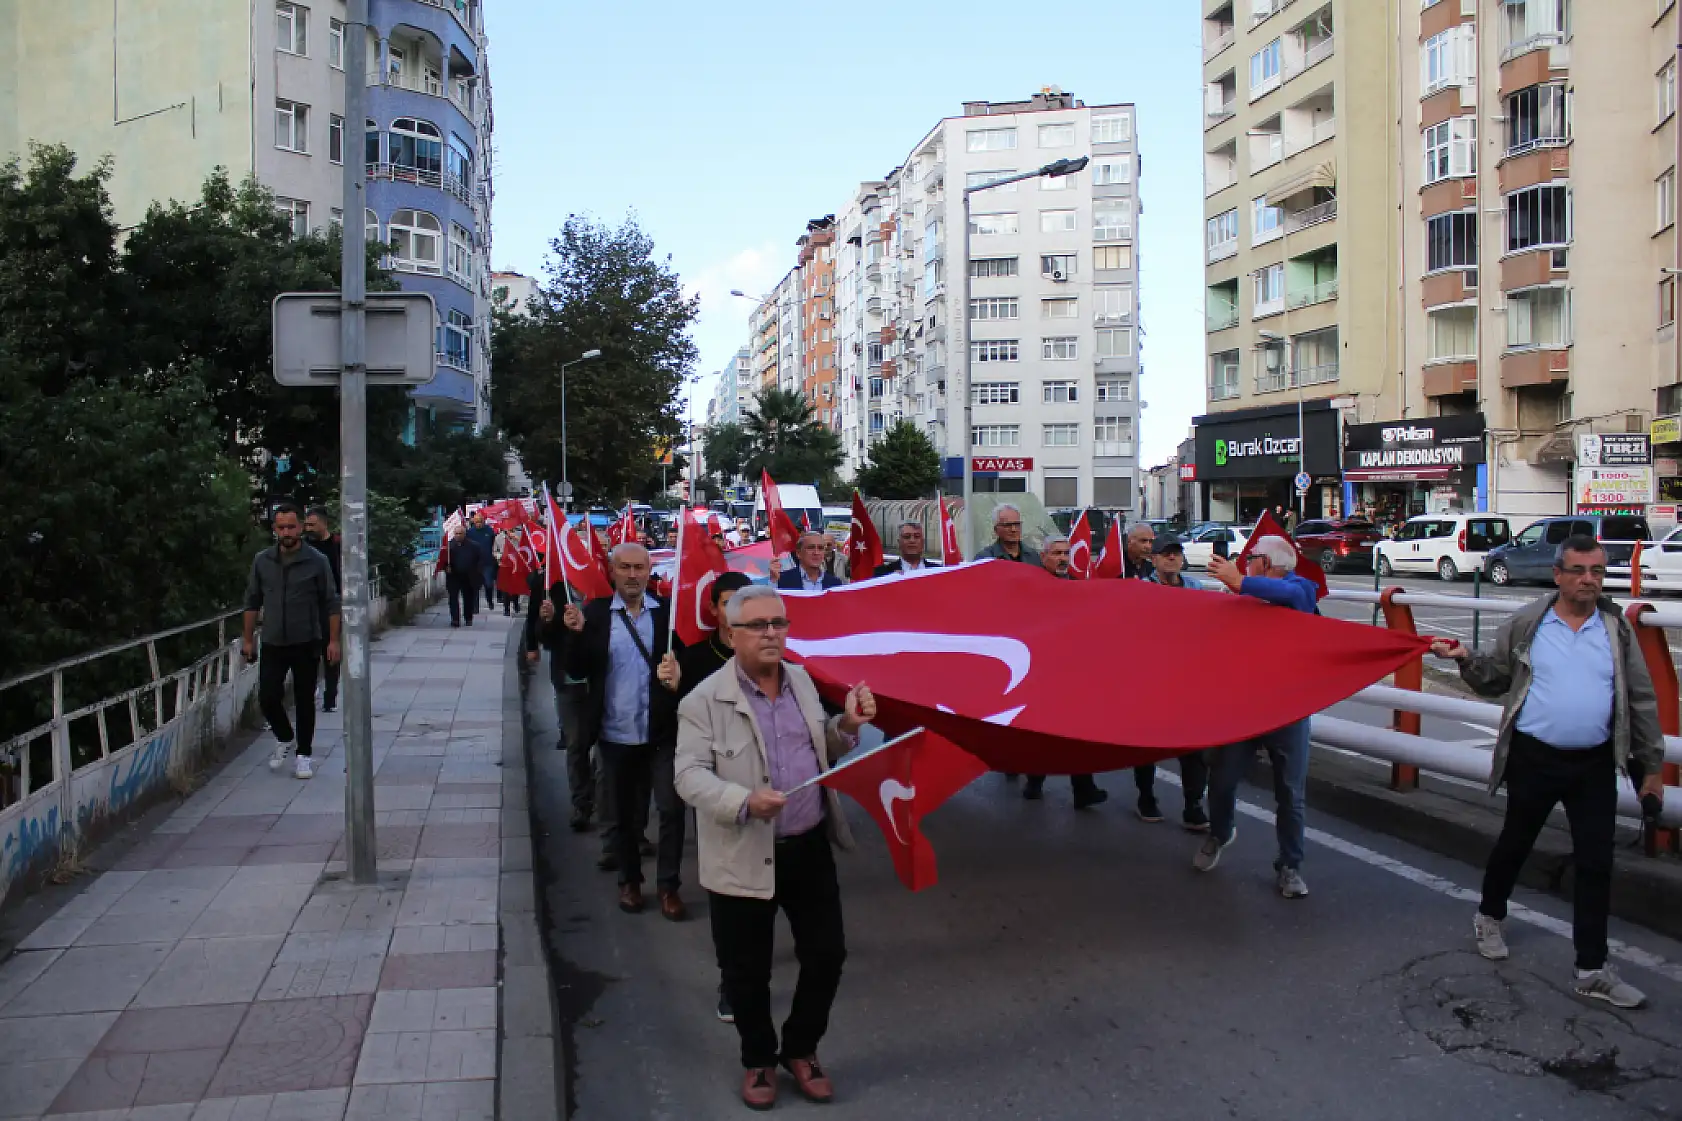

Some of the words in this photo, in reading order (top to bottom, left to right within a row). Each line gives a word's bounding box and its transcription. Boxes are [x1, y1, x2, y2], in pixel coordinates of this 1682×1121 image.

[1228, 437, 1262, 457] Burak
[1361, 450, 1395, 467] KAPLAN
[1397, 446, 1462, 465] DEKORASYON
[1592, 493, 1624, 502] 1300
